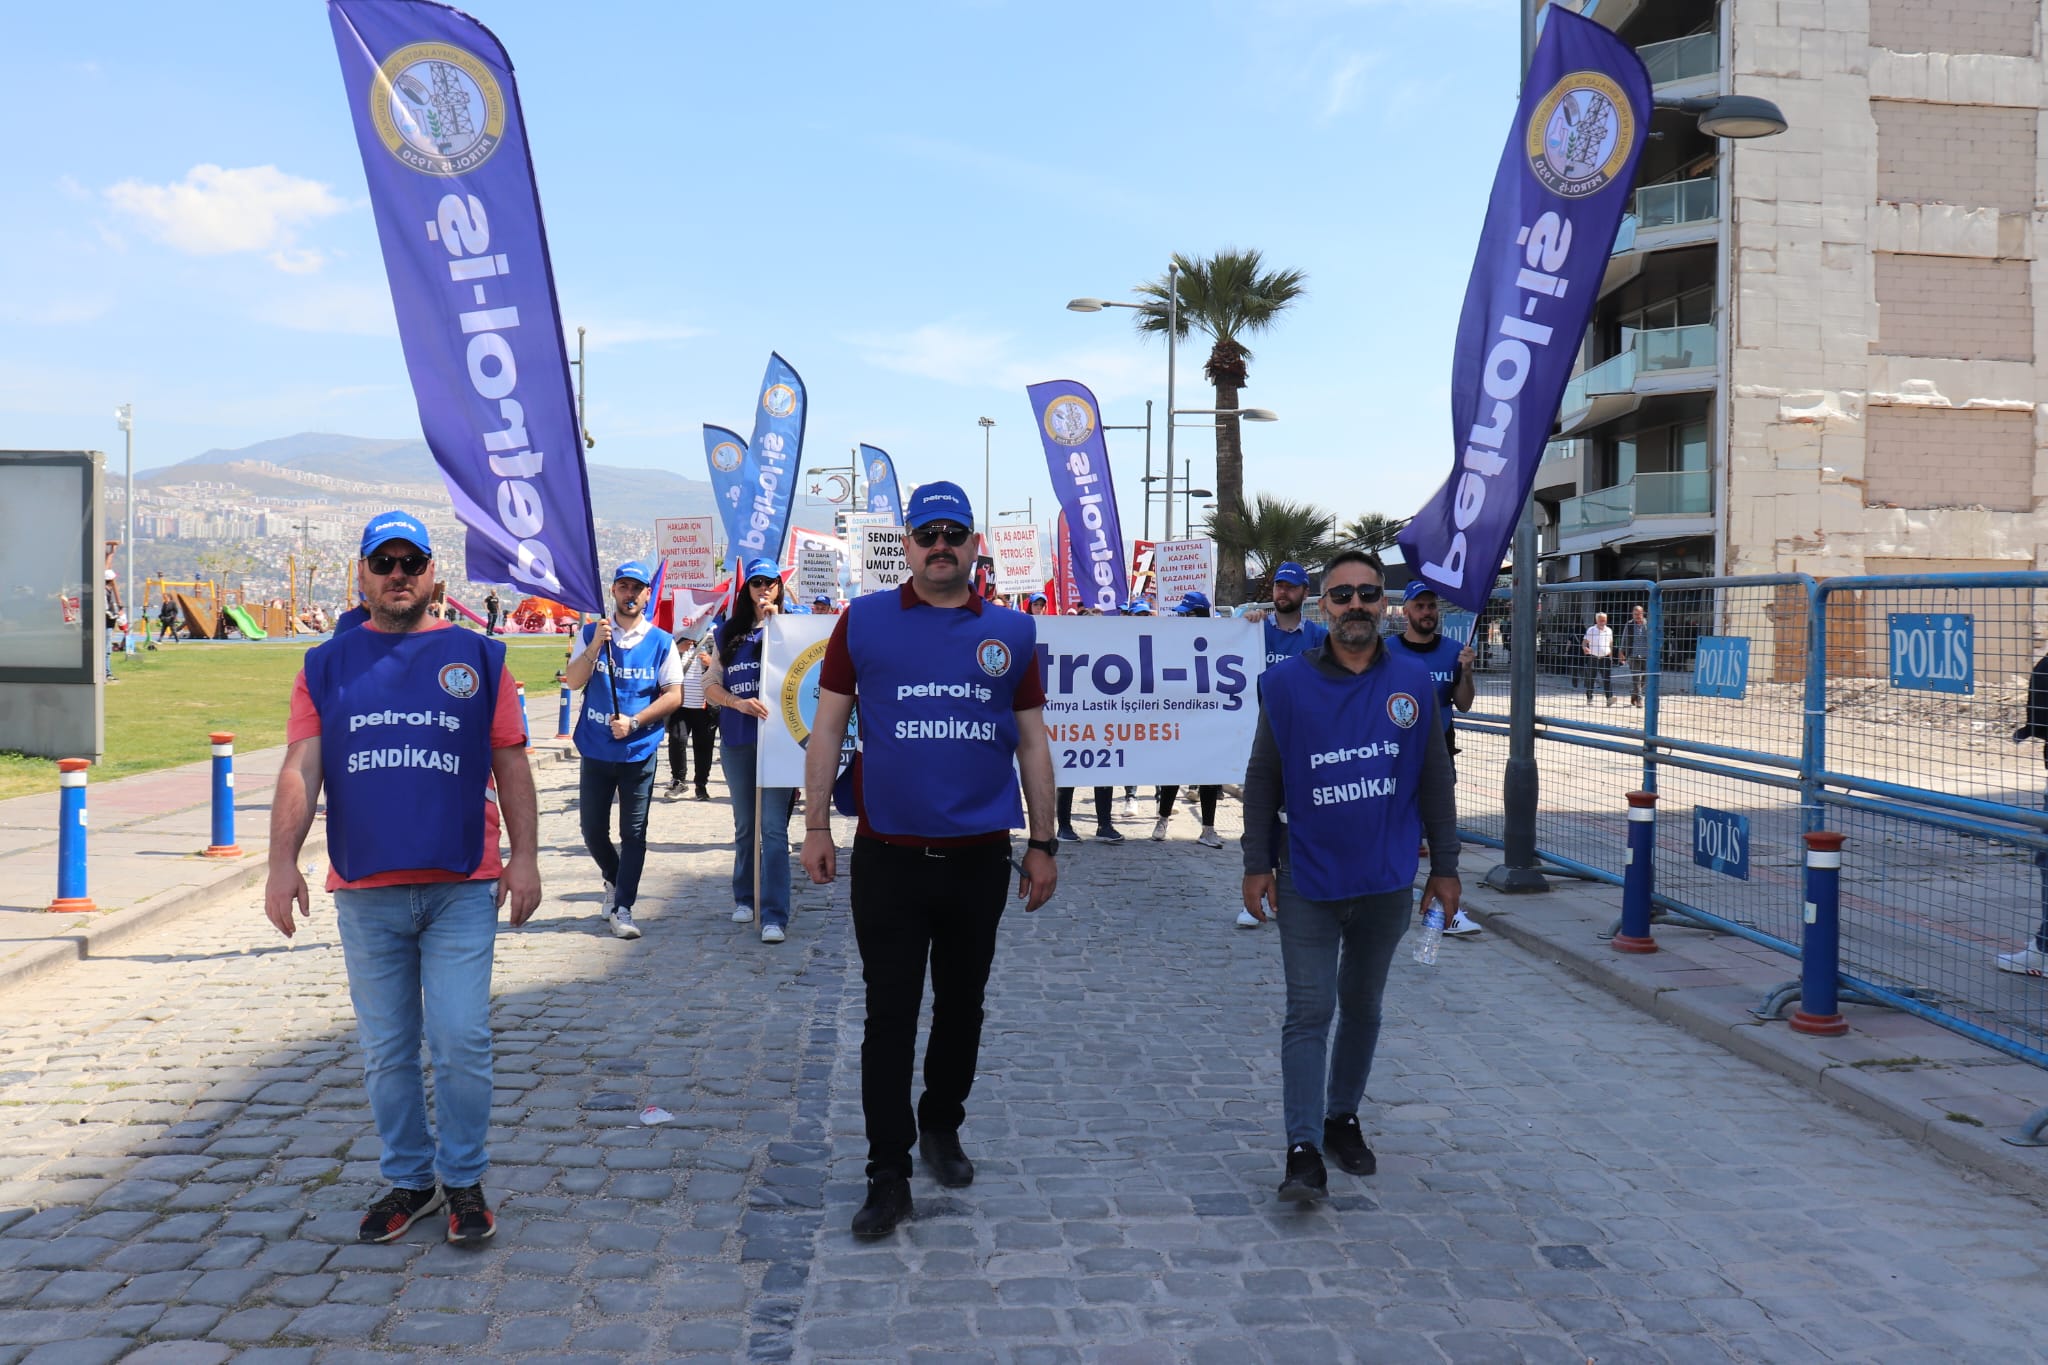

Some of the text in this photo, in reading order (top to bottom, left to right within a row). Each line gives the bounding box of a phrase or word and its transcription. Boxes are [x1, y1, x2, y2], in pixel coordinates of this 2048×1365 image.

[867, 530, 905, 543] SENDİK
[1013, 530, 1035, 541] ADALET
[873, 546, 906, 557] VARSA
[1175, 543, 1203, 551] KUTSAL
[866, 560, 895, 570] UMUT
[1006, 566, 1031, 577] EMANET
[879, 574, 899, 584] VAR
[1162, 573, 1207, 583] KAZANILAN
[1174, 584, 1197, 592] HELAL
[1892, 617, 1968, 681] POLİS
[727, 661, 760, 676] petro
[1036, 635, 1247, 711] trol-iş
[1696, 641, 1743, 688] POLİS
[786, 658, 809, 692] PETROL
[730, 679, 760, 695] SENDİK
[897, 682, 992, 703] petrol-iş
[1082, 698, 1117, 711] Lastik
[1121, 697, 1160, 713] İşçileri
[1163, 697, 1219, 711] Sendikası
[349, 709, 461, 732] petrol-iş
[894, 716, 997, 741] SENDİKASI
[1044, 723, 1097, 742] NİSA
[347, 744, 460, 775] SENDİKASI
[1062, 748, 1125, 769] 2021
[1310, 740, 1400, 769] petrol-iş
[1312, 777, 1397, 806] SENDİKAI
[1698, 817, 1741, 865] POLİS
